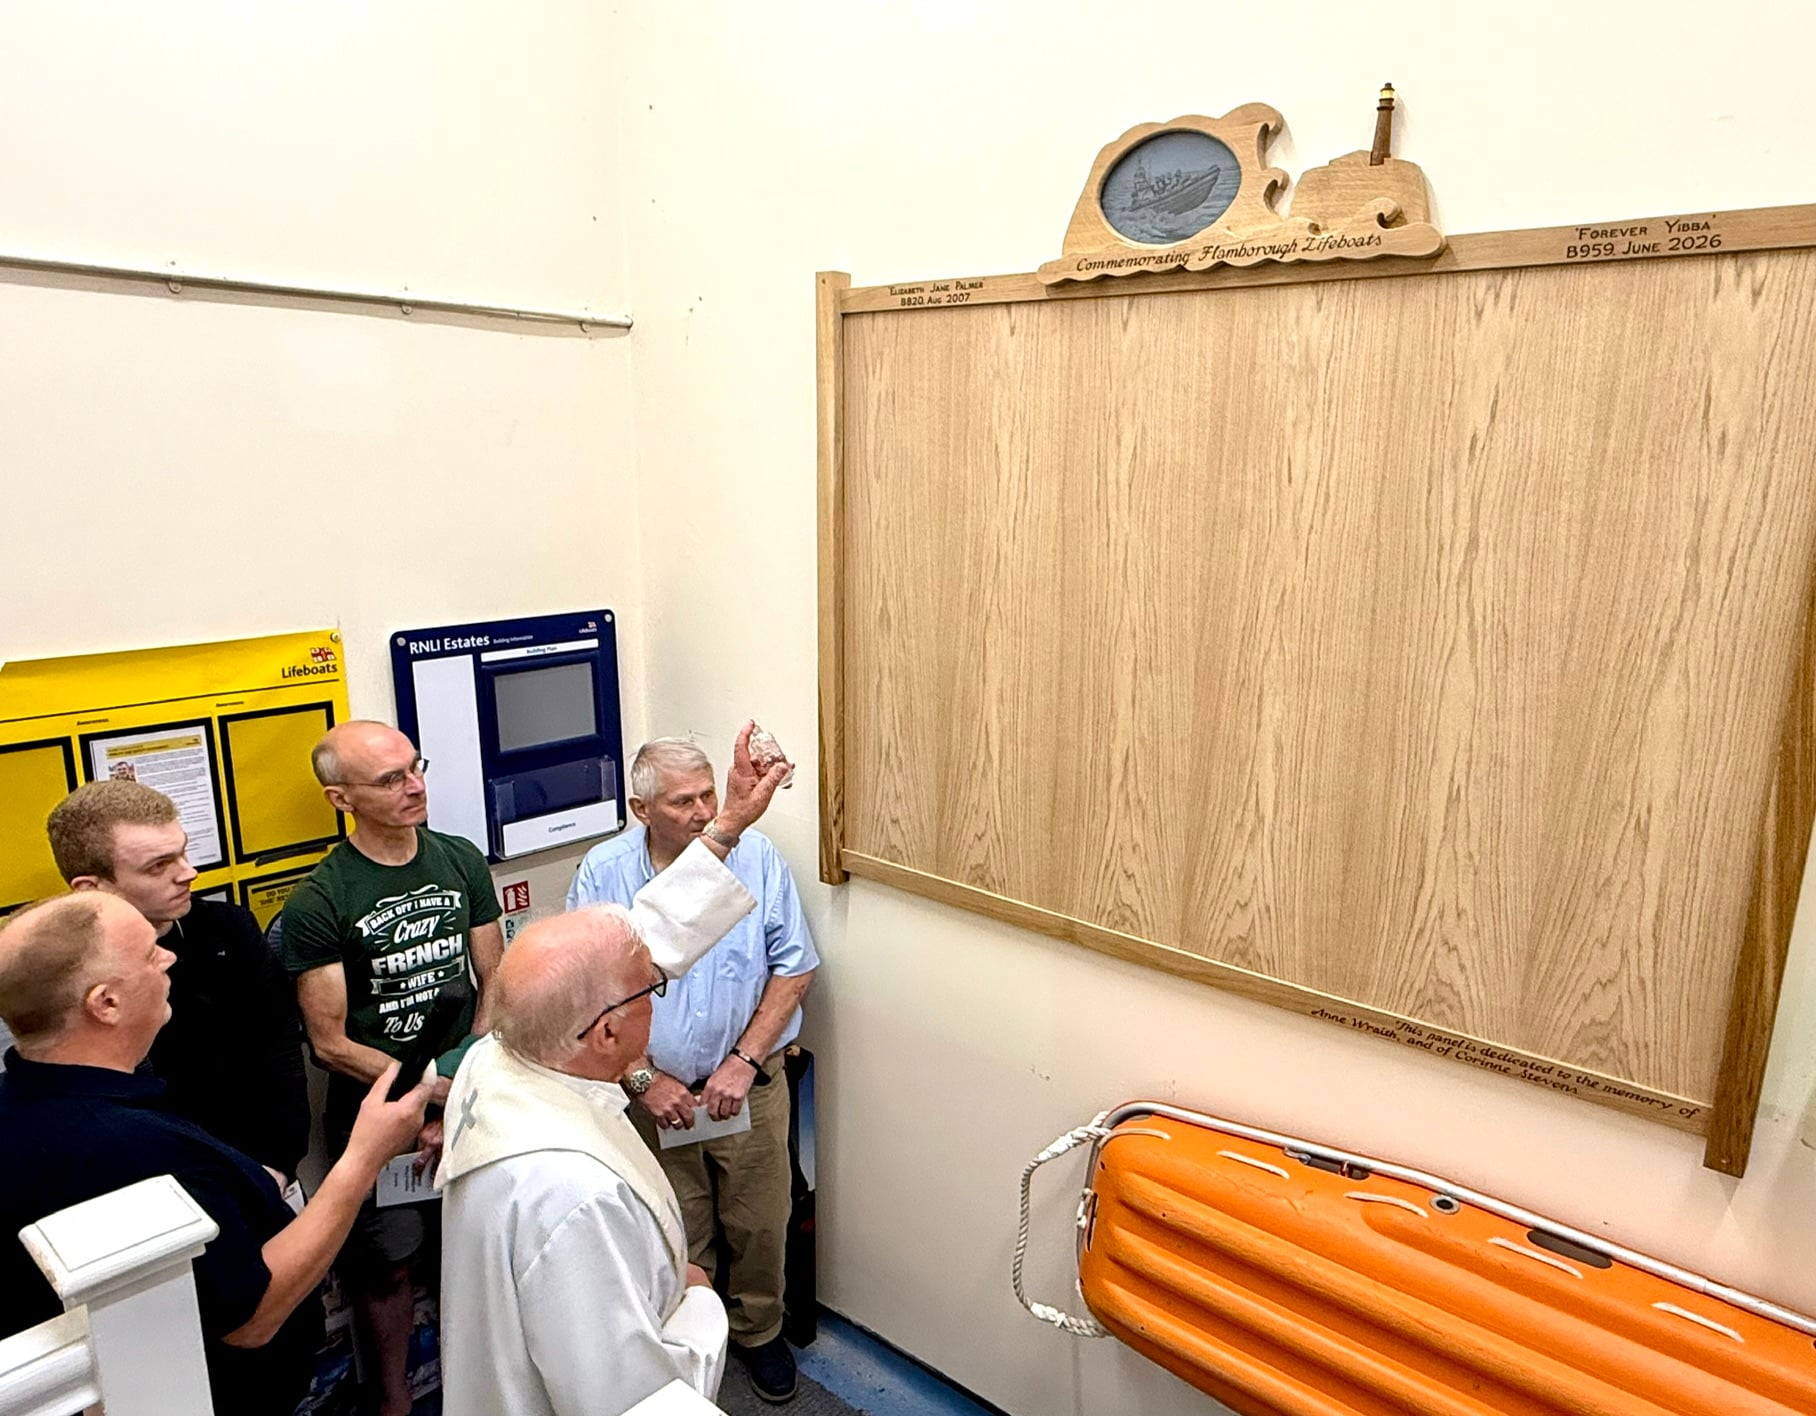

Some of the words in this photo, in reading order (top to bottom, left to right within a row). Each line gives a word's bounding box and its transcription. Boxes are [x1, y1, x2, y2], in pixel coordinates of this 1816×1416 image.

[1076, 249, 1191, 272] Commemorating
[1198, 241, 1298, 262] Flamborough
[1302, 233, 1383, 252] Lifeboats
[1668, 234, 1722, 251] 2026
[946, 292, 971, 303] 2007
[409, 639, 441, 655] RNLI
[443, 634, 490, 650] Estates
[281, 663, 338, 679] Lifeboats
[369, 911, 395, 930] BACK
[396, 901, 412, 914] OFF
[419, 897, 443, 907] HAVE
[443, 897, 451, 906] A
[393, 915, 440, 944] Crazy
[371, 933, 463, 976] FRENCH
[407, 972, 436, 990] WIFE
[379, 1000, 399, 1014] AND
[400, 996, 415, 1009] I'M
[416, 989, 433, 1004] NOT
[383, 1017, 403, 1034] To
[403, 1012, 425, 1033] Us
[1311, 1008, 1347, 1025] Anne
[1406, 1036, 1435, 1050] and
[1436, 1045, 1453, 1057] of
[1455, 1050, 1511, 1074] Corinne
[1519, 1068, 1578, 1095] Stevens
[1425, 1032, 1465, 1048] panel
[1465, 1041, 1477, 1053] is
[1480, 1047, 1555, 1075] dedicated
[1556, 1070, 1572, 1080] to
[1575, 1075, 1599, 1089] the
[1601, 1084, 1673, 1110] memory
[1678, 1107, 1700, 1119] of
